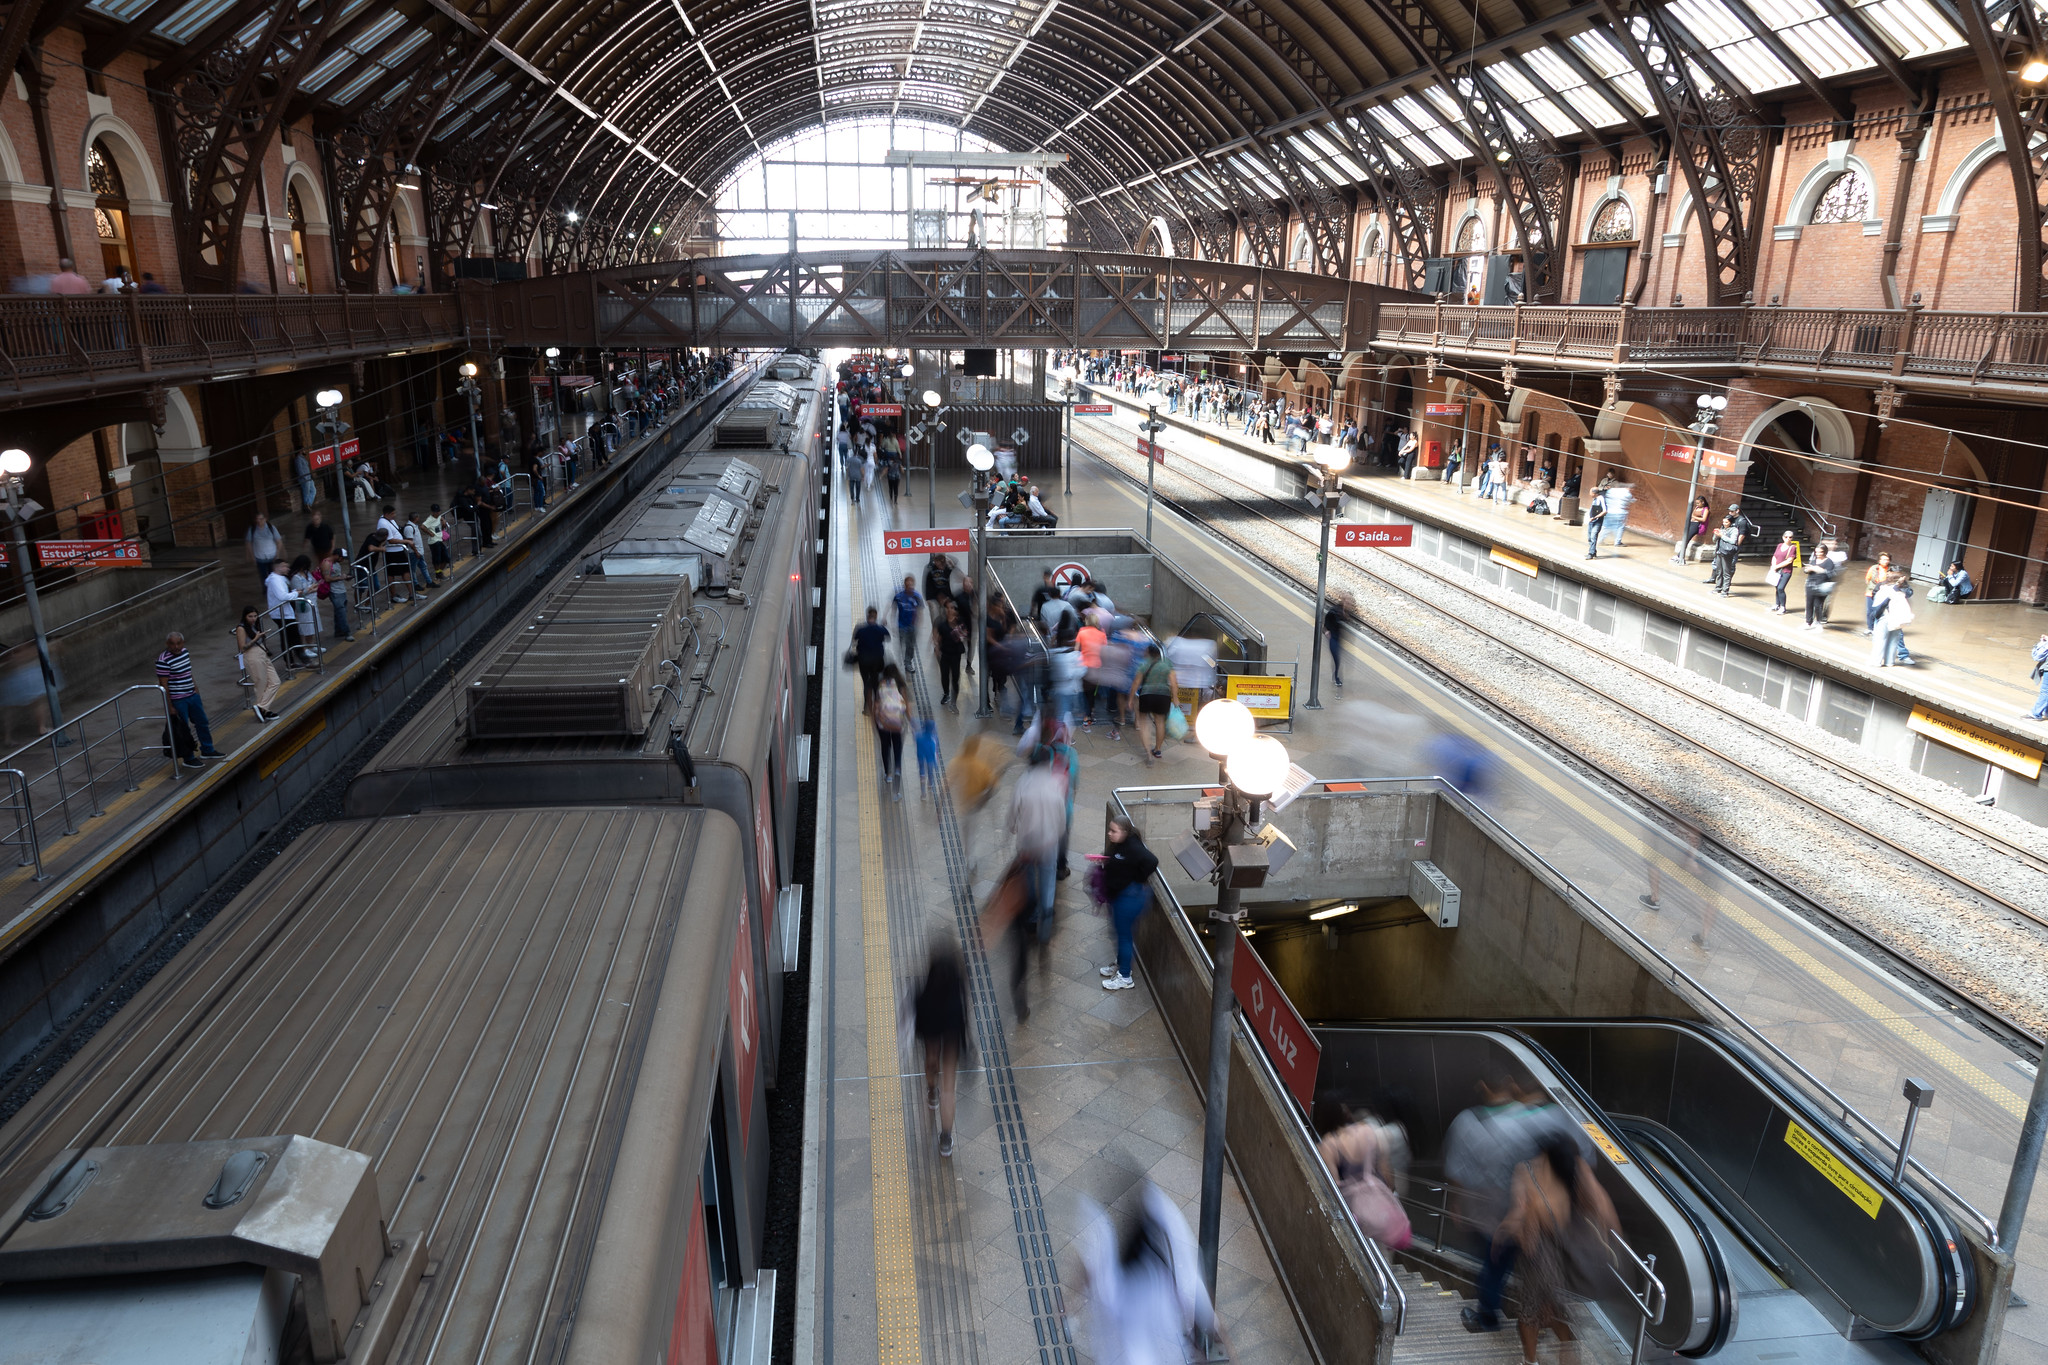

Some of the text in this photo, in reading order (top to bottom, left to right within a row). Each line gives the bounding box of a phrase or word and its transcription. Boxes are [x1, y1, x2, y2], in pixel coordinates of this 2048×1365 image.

[915, 536, 953, 547] Saída
[1358, 531, 1390, 541] Saída
[1926, 712, 1930, 721] É
[1932, 716, 1967, 736] proibido
[1969, 730, 1997, 746] descer
[1999, 743, 2010, 752] na
[2012, 747, 2026, 759] via
[1269, 1006, 1297, 1069] Luz
